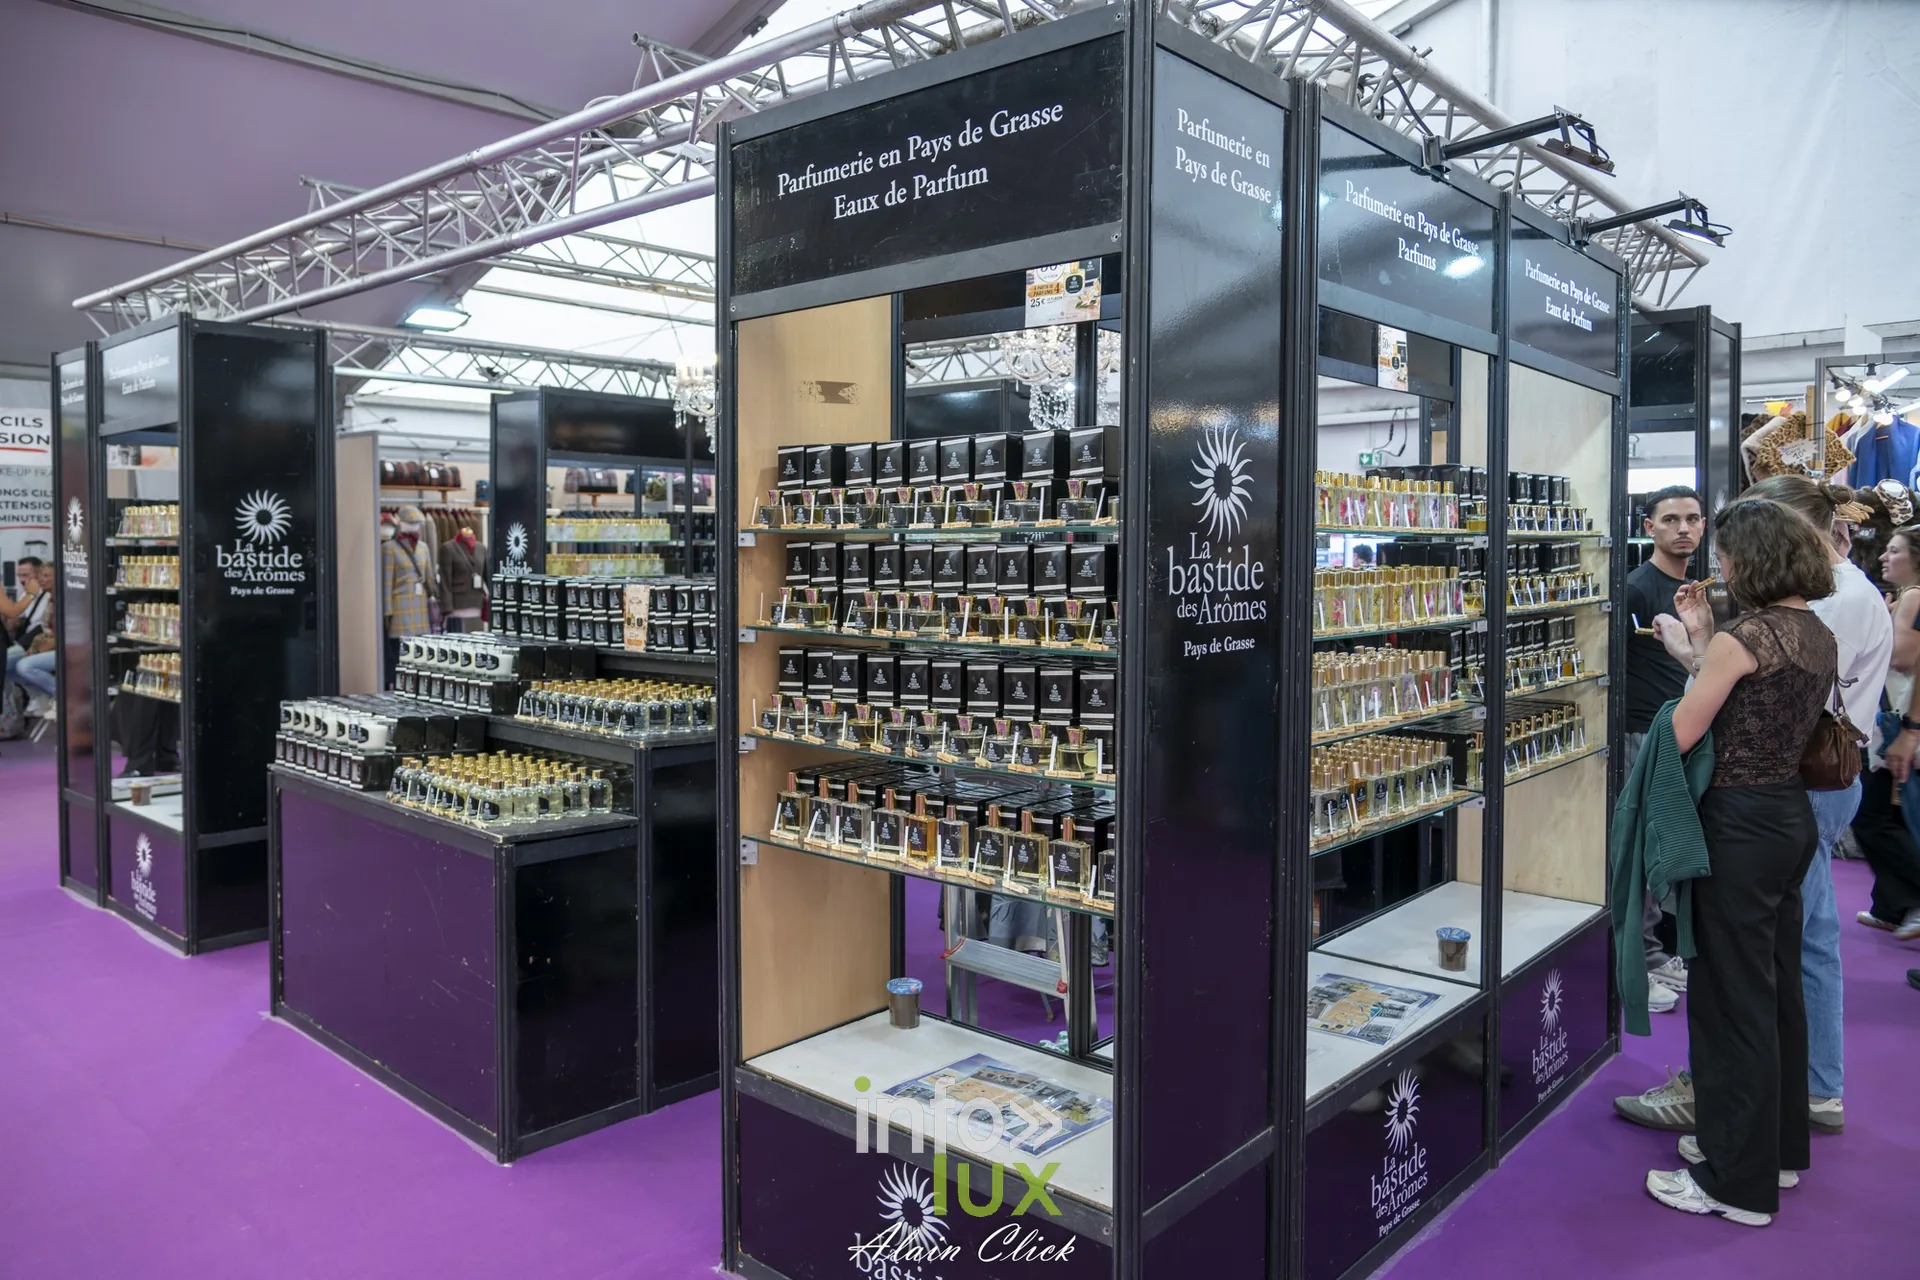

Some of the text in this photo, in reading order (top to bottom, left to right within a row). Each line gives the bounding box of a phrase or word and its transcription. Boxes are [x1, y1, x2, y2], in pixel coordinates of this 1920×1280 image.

[778, 104, 1063, 196] Parfumerie en Pays de Grasse
[1177, 108, 1270, 168] Parfumerie en
[833, 164, 989, 219] Eaux de Parfum
[1175, 146, 1271, 203] Pays de Grasse
[1345, 180, 1479, 256] Parfumerie en Pays de Grasse
[1398, 237, 1436, 271] Parfums
[1525, 258, 1610, 314] Parfumerie en Pays de Grasse
[1546, 296, 1592, 332] Eaux de Parfum
[215, 544, 303, 568] bastide
[234, 538, 255, 553] La
[1189, 532, 1211, 559] La
[224, 566, 306, 582] des Arômes
[1167, 544, 1264, 596] bastide
[230, 586, 295, 597] Pays de Grasse
[1177, 593, 1267, 625] des Arômes
[1183, 636, 1255, 660] Pays de Grasse
[1532, 1026, 1568, 1075] bastide
[1370, 1142, 1427, 1209] bastide
[1383, 1155, 1396, 1177] La
[1376, 1171, 1428, 1220] des Arômes
[1379, 1198, 1421, 1238] Pays de Grasse
